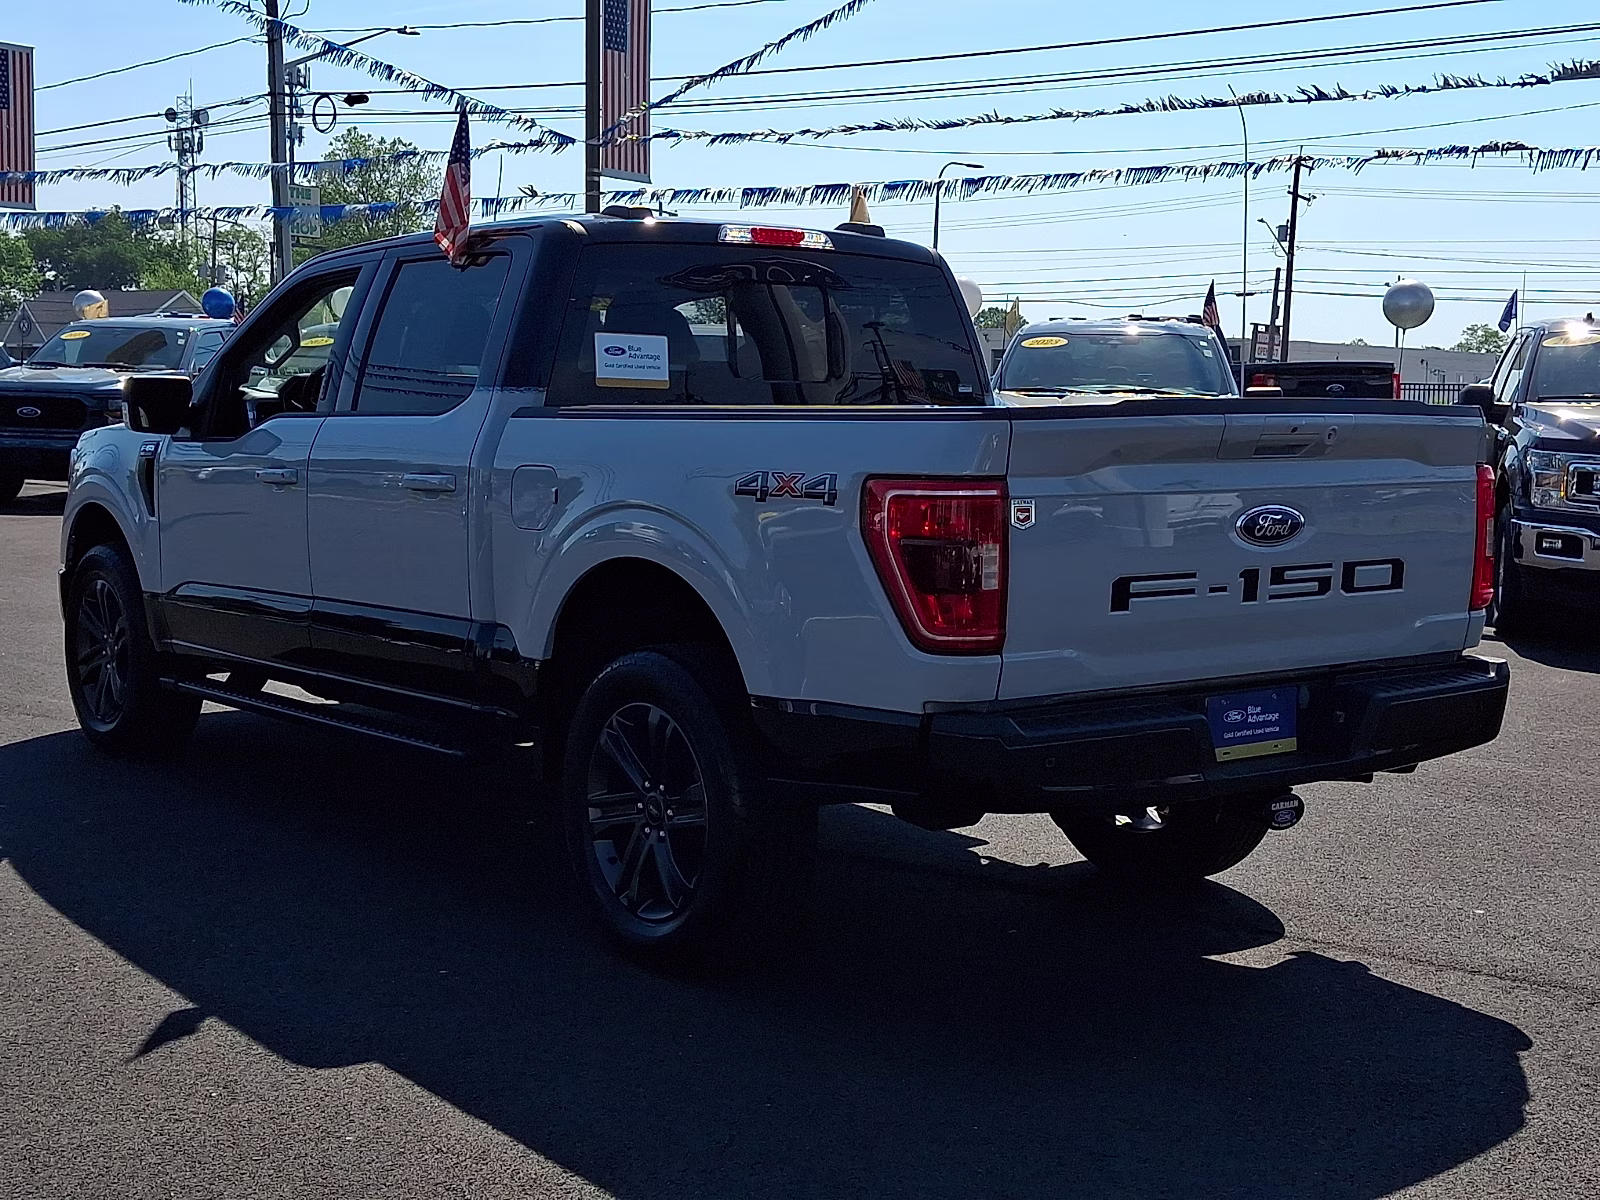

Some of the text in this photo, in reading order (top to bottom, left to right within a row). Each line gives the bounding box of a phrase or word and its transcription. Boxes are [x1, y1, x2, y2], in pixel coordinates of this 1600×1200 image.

[289, 187, 311, 200] THE
[290, 221, 317, 235] HOP
[628, 353, 661, 361] Advantage
[1255, 513, 1292, 537] Ford
[1109, 557, 1405, 614] F-150
[1247, 705, 1262, 714] Blue
[1247, 712, 1280, 723] Advantage
[1223, 725, 1280, 739] Gold Certified Used Vehicle
[1271, 800, 1298, 810] CARMAN
